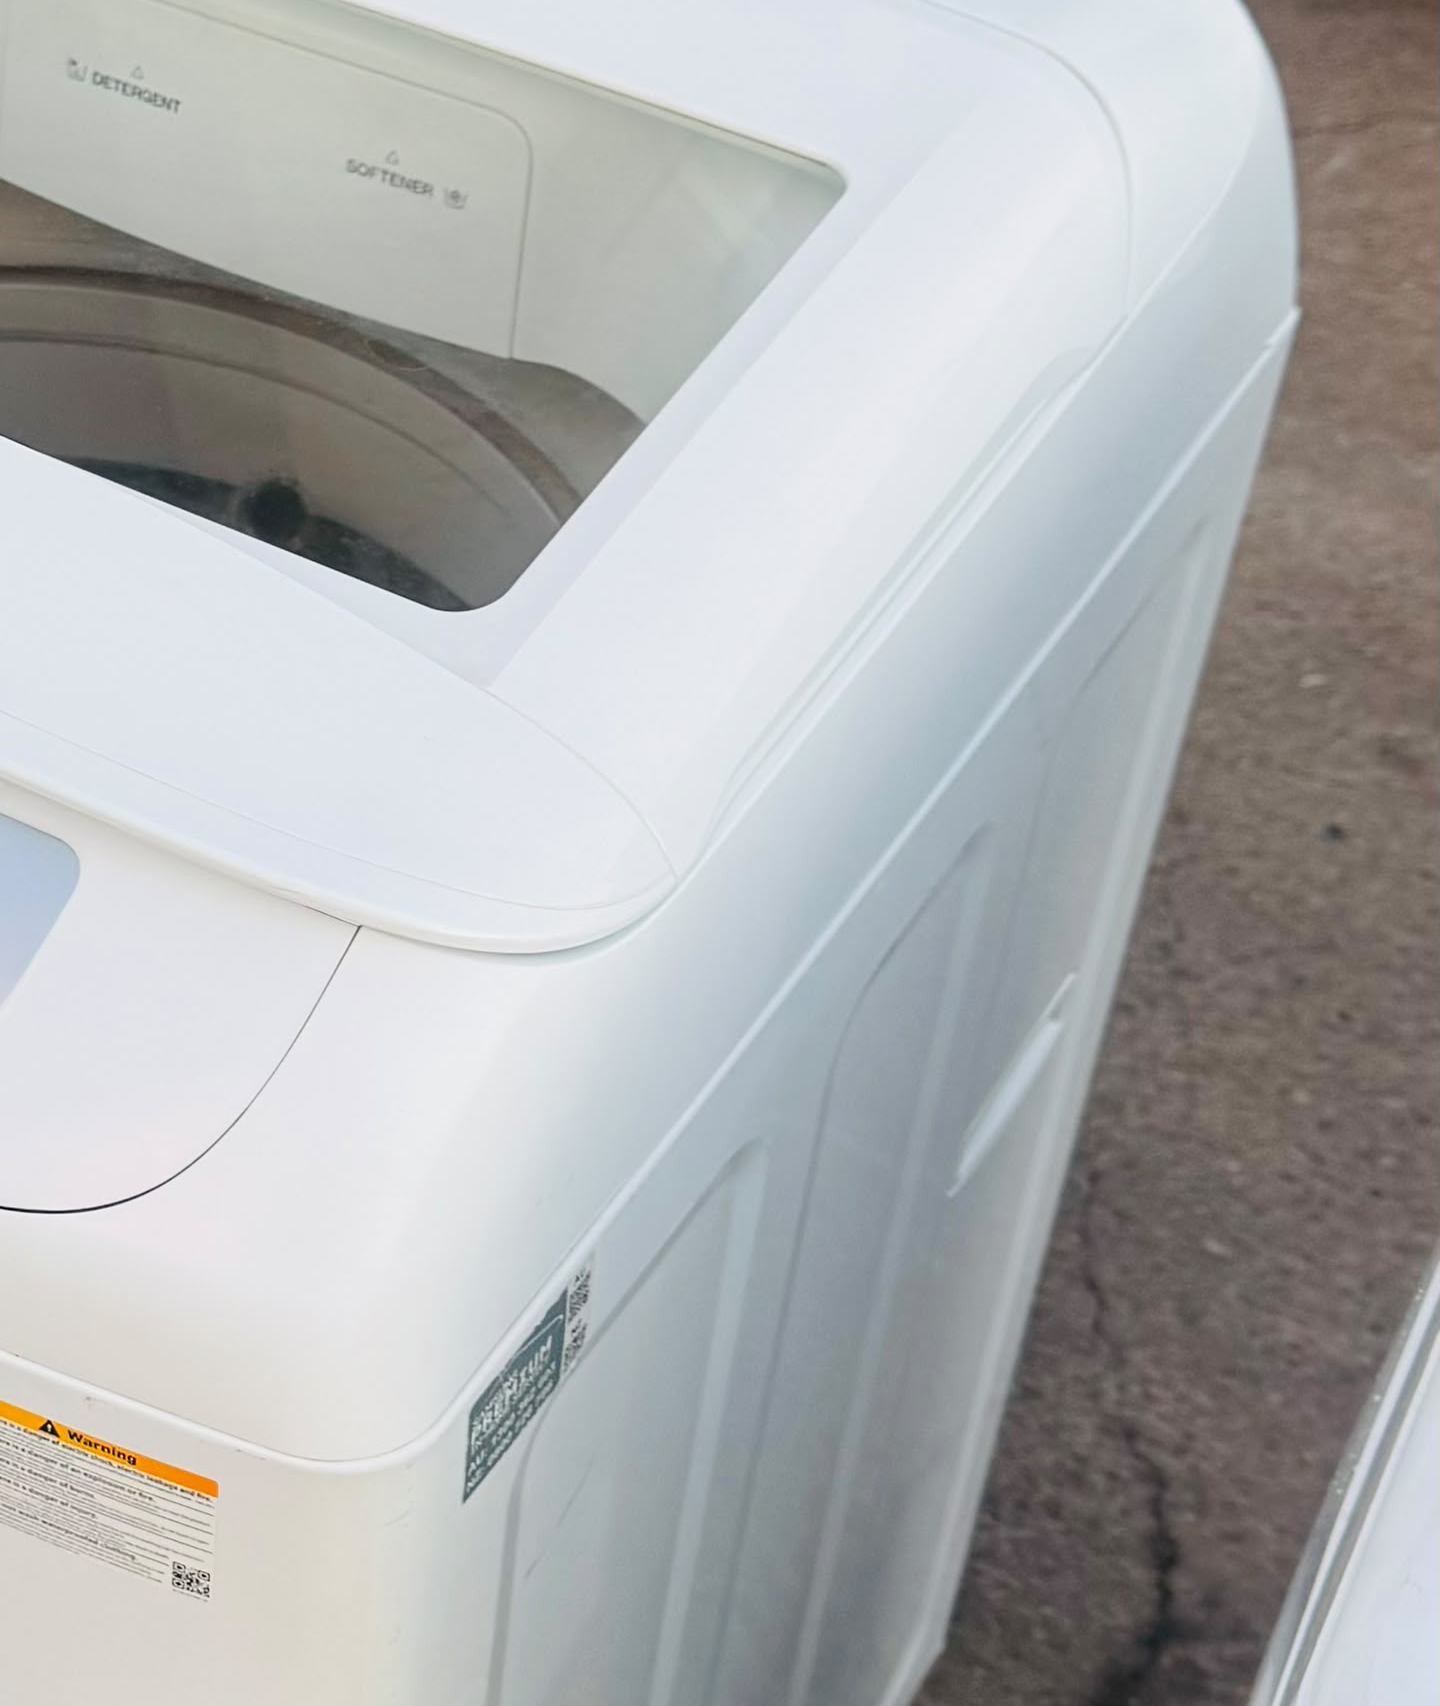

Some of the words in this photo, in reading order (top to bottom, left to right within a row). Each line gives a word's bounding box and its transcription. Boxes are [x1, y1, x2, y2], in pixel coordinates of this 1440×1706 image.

[91, 70, 183, 115] DETERGENT
[345, 157, 436, 198] SOFTENER
[67, 1429, 138, 1467] Warning
